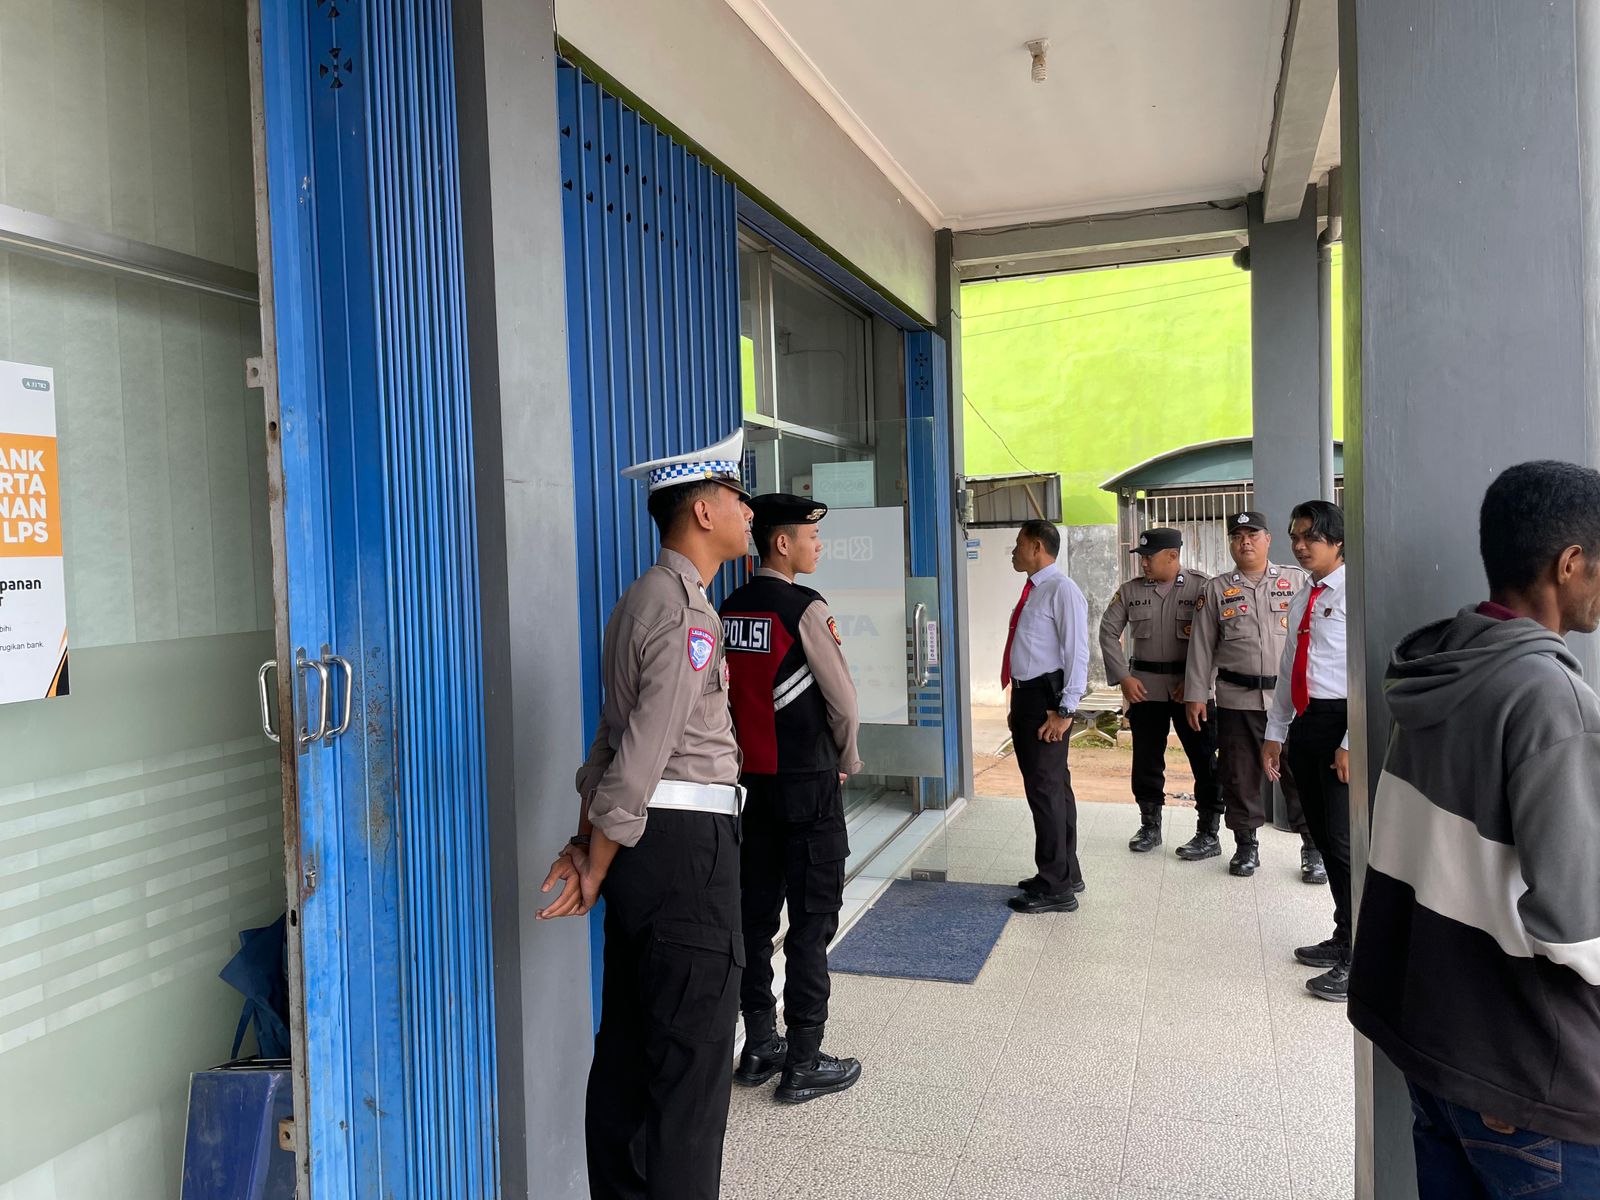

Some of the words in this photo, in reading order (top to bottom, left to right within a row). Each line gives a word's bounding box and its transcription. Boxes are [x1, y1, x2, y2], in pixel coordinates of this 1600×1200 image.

[3, 521, 49, 543] LPS
[1129, 599, 1151, 607] ADJI
[724, 620, 768, 649] POLISI
